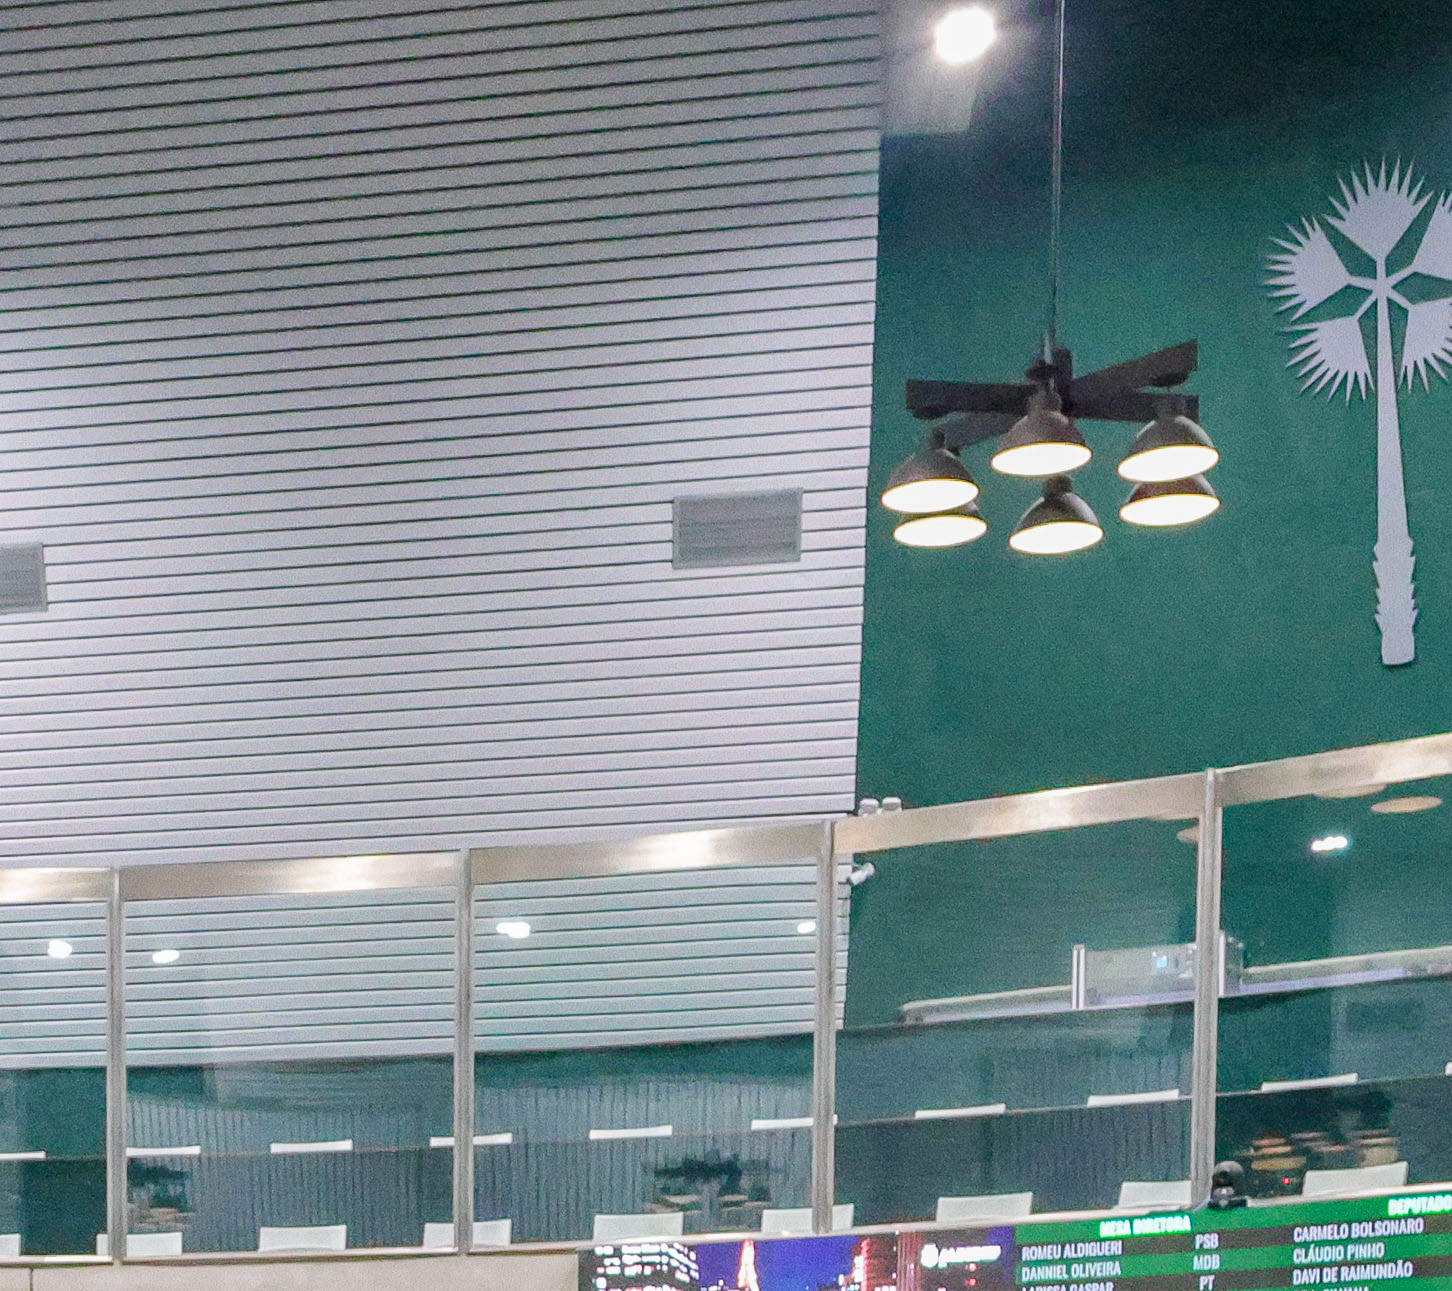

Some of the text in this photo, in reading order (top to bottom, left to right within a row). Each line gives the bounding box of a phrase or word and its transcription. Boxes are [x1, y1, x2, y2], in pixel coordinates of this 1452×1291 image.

[1294, 1218, 1424, 1242] CARMELO BOLSONARO
[1022, 1241, 1122, 1260] ROMEU ALDIGUERI
[1196, 1233, 1218, 1249] PSB
[1194, 1254, 1219, 1269] MDB
[1294, 1243, 1384, 1263] CLÁUDIO PINHO
[1022, 1262, 1121, 1281] DANNIEL OLIVEIRA
[1294, 1261, 1413, 1284] DAVI DE RAIMUNDÃO
[1200, 1275, 1214, 1290] PT
